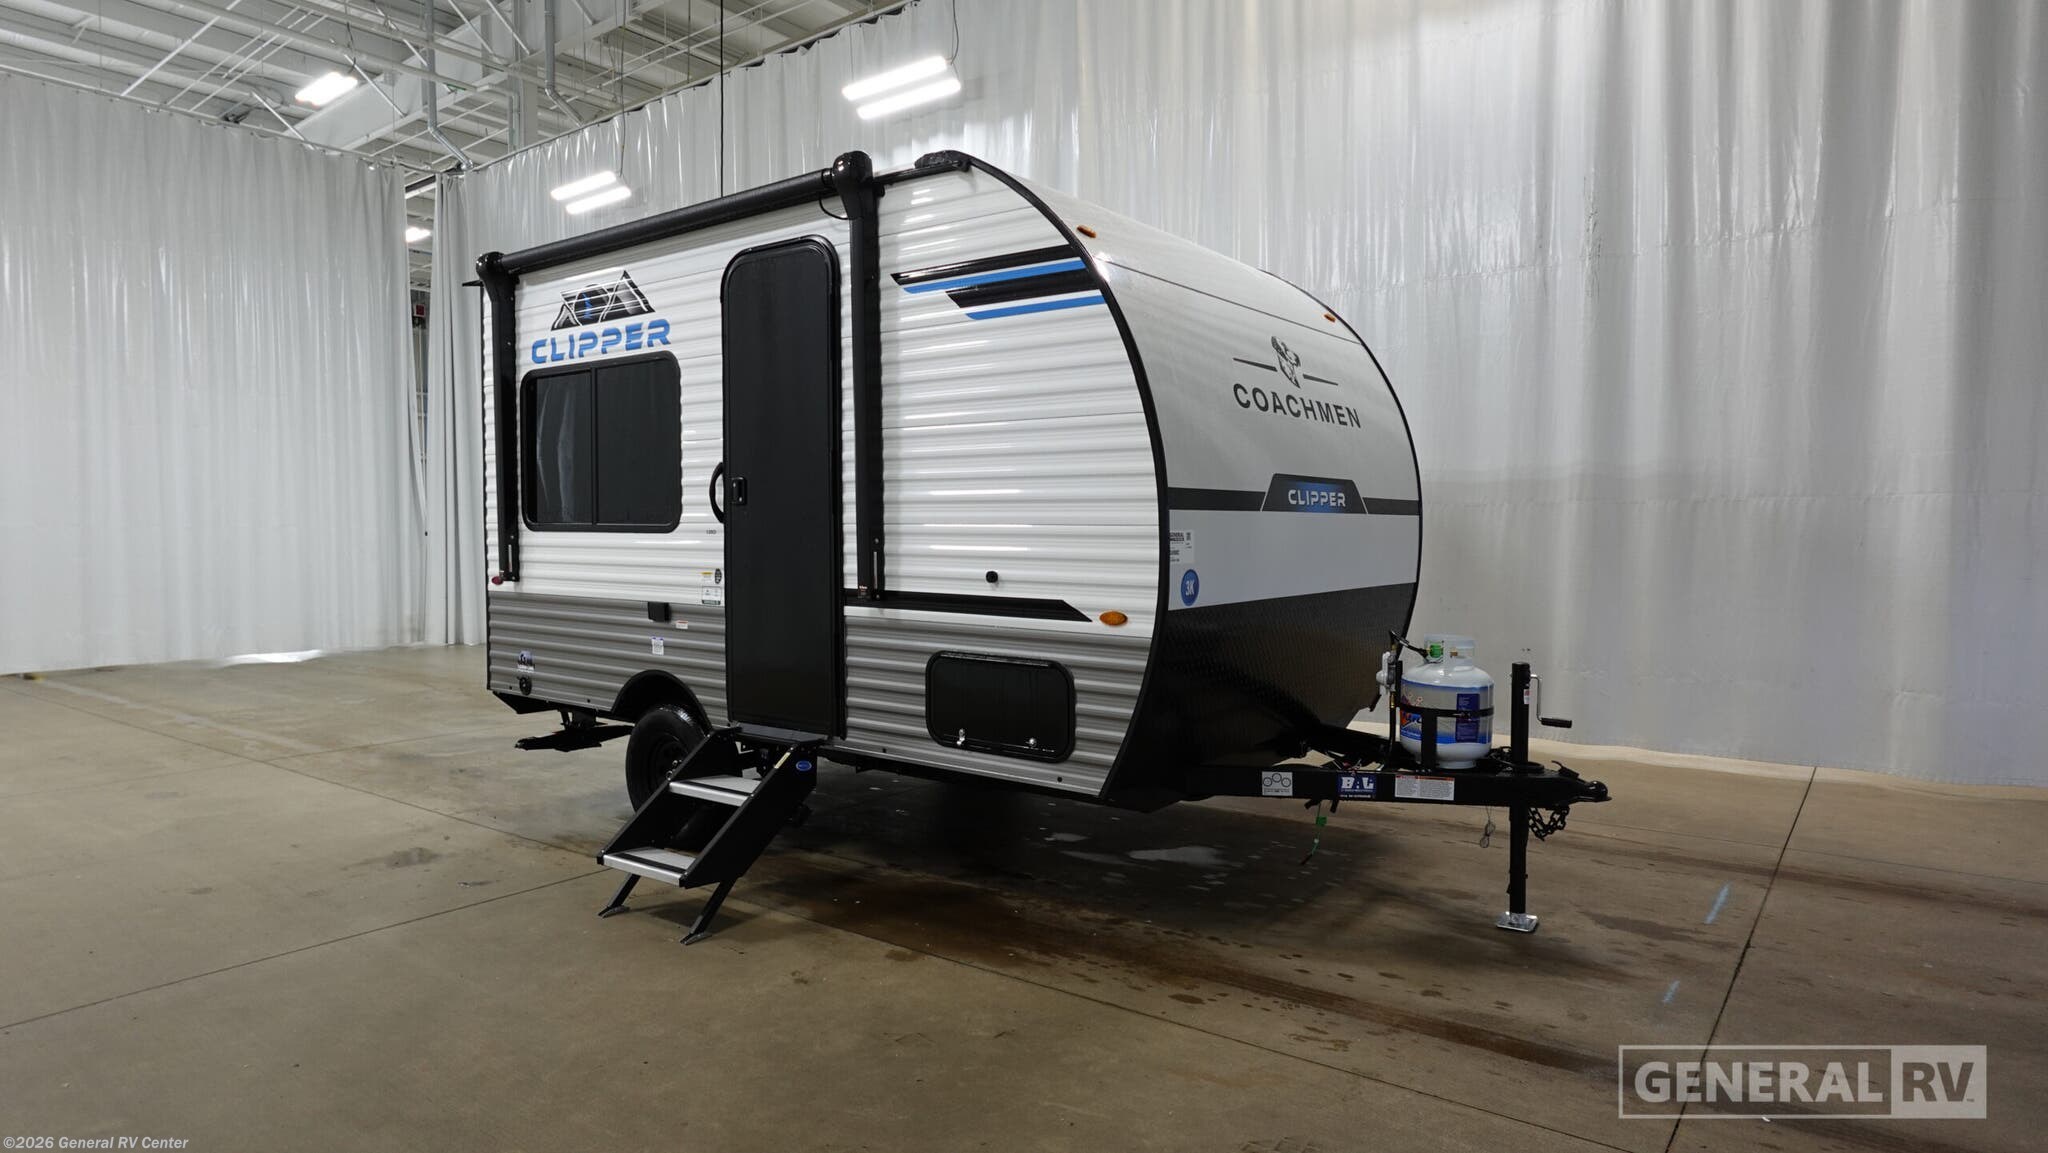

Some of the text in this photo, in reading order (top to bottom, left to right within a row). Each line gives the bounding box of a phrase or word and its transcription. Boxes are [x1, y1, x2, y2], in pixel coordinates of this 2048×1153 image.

[531, 319, 671, 364] CLIPPER
[1233, 383, 1361, 428] COACHMEN
[1288, 490, 1346, 507] CLIPPER
